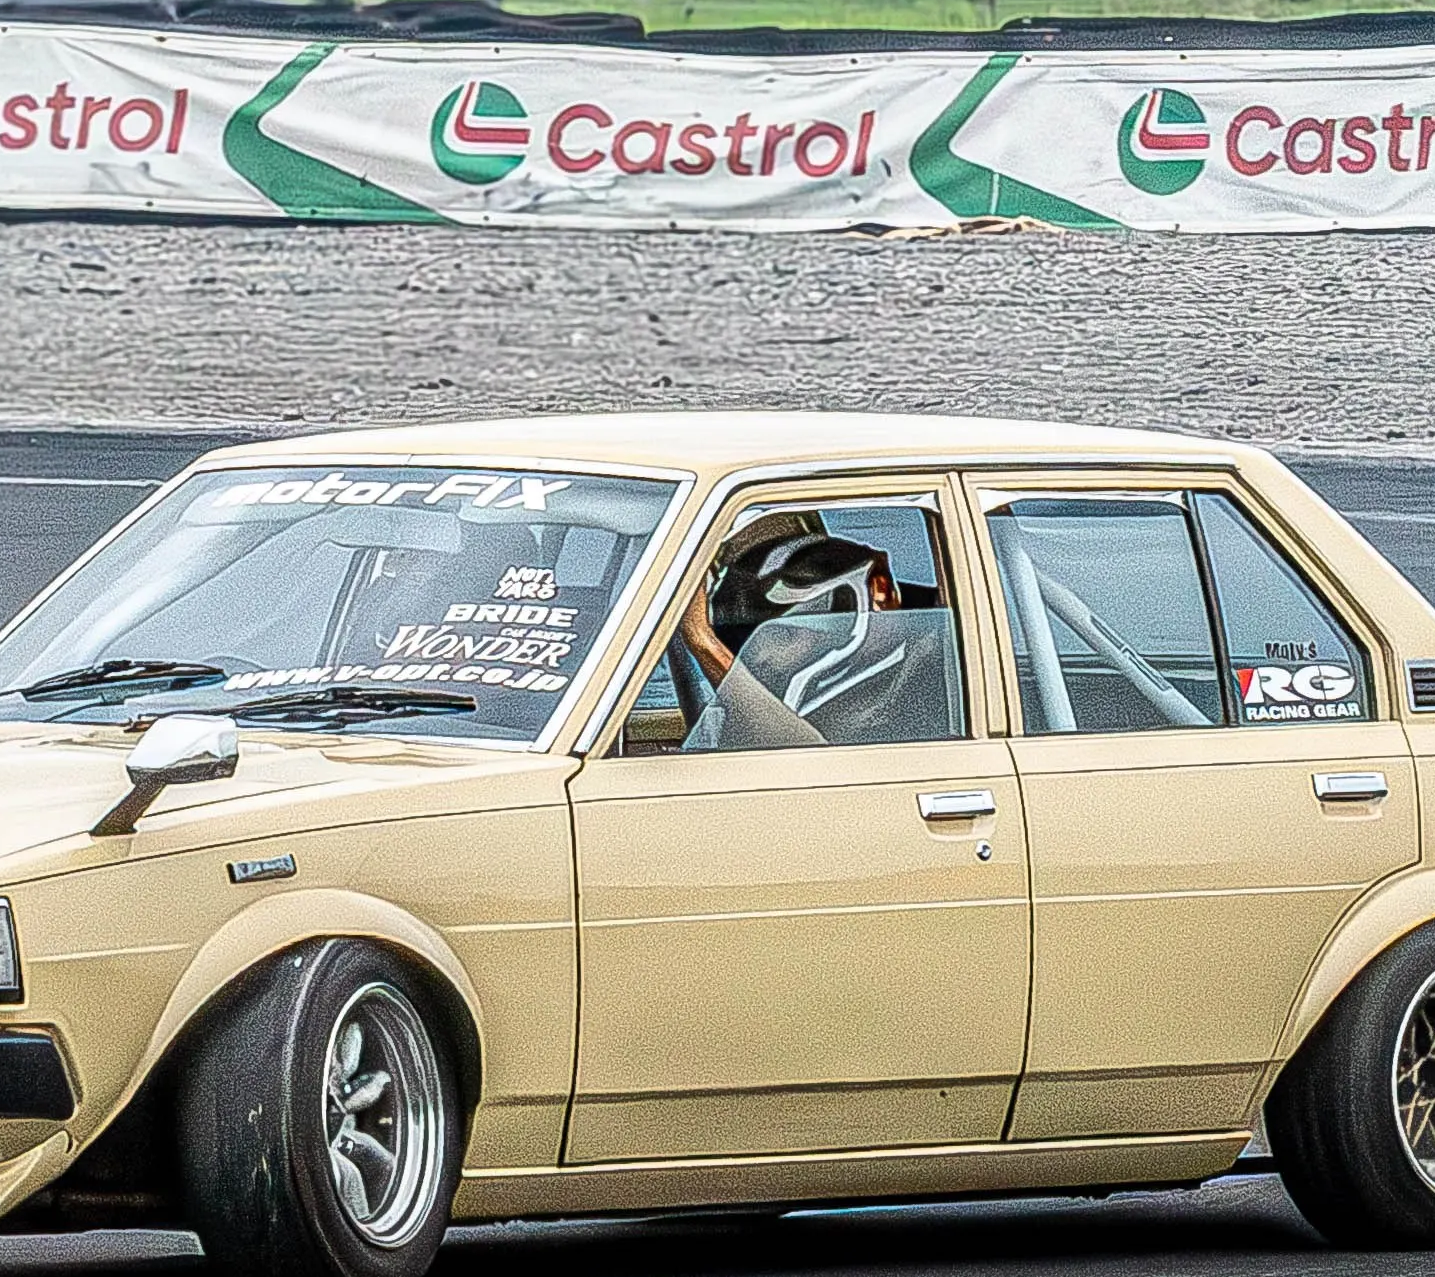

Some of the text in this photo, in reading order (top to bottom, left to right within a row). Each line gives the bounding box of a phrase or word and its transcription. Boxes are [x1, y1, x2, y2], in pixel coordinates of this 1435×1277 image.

[546, 103, 875, 178] Castrol
[443, 603, 579, 628] BRIDE
[1246, 702, 1362, 721] RACING GEAR
